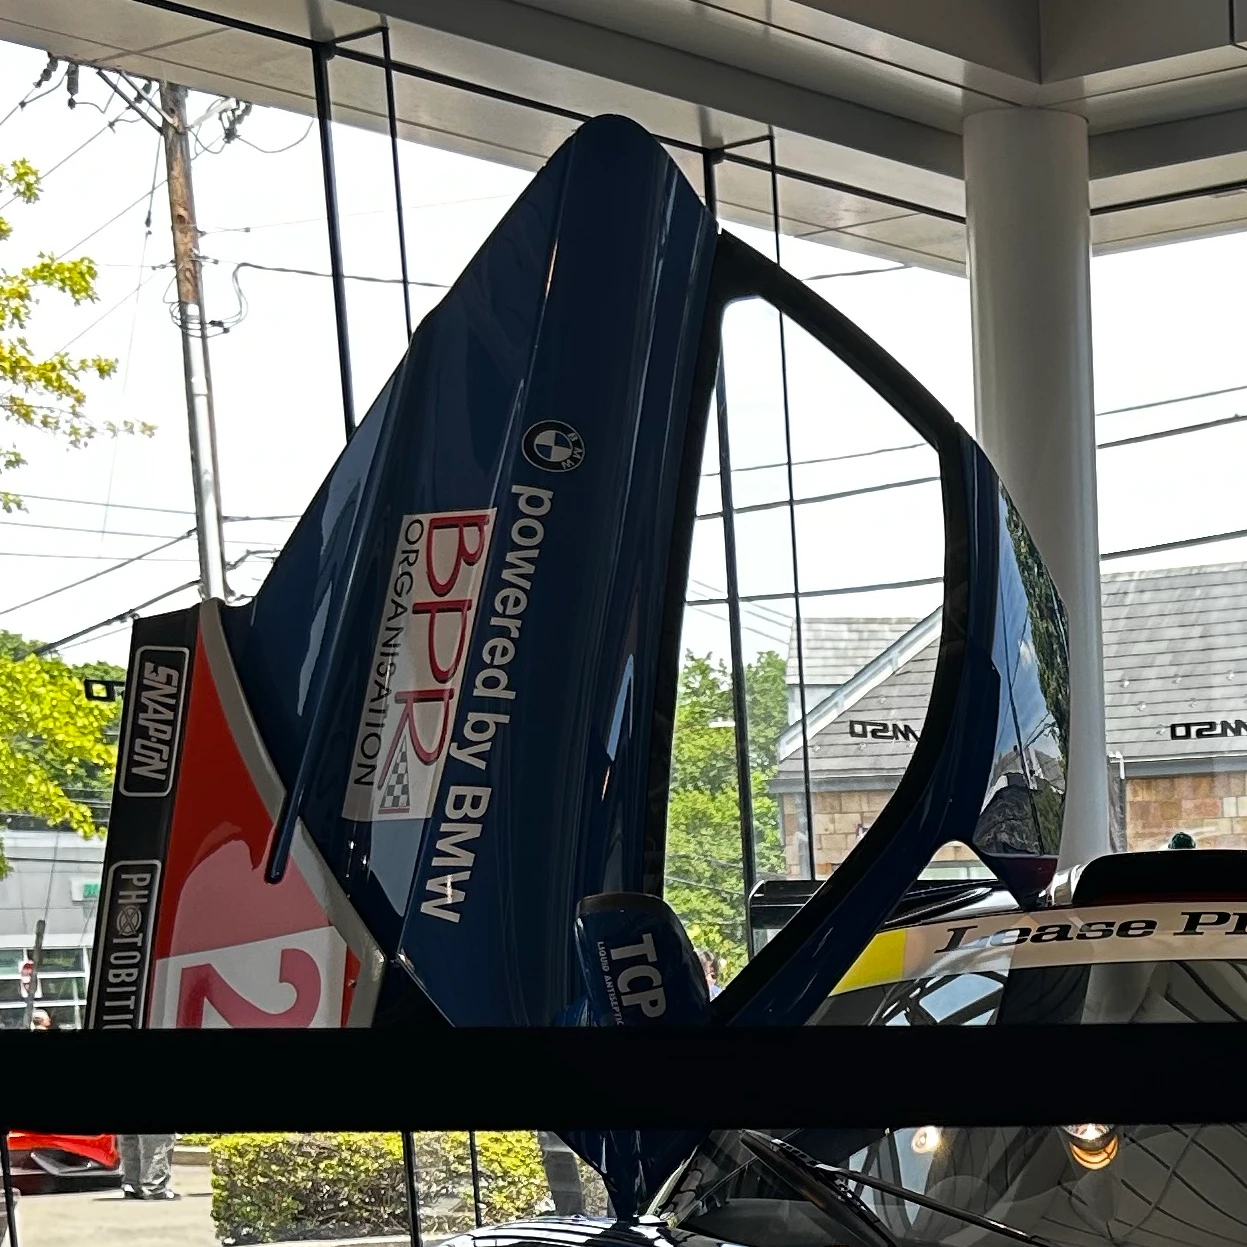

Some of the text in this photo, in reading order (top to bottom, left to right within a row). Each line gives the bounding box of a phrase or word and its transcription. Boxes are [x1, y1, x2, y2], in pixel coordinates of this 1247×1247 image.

[561, 432, 583, 470] BMW
[353, 518, 424, 787] ORGANISATION
[377, 514, 490, 790] BPR
[420, 484, 554, 923] powered by BMW
[597, 941, 610, 972] LIQUID
[610, 933, 667, 1018] TCP
[933, 916, 1155, 954] Lease
[176, 948, 321, 1029] 2
